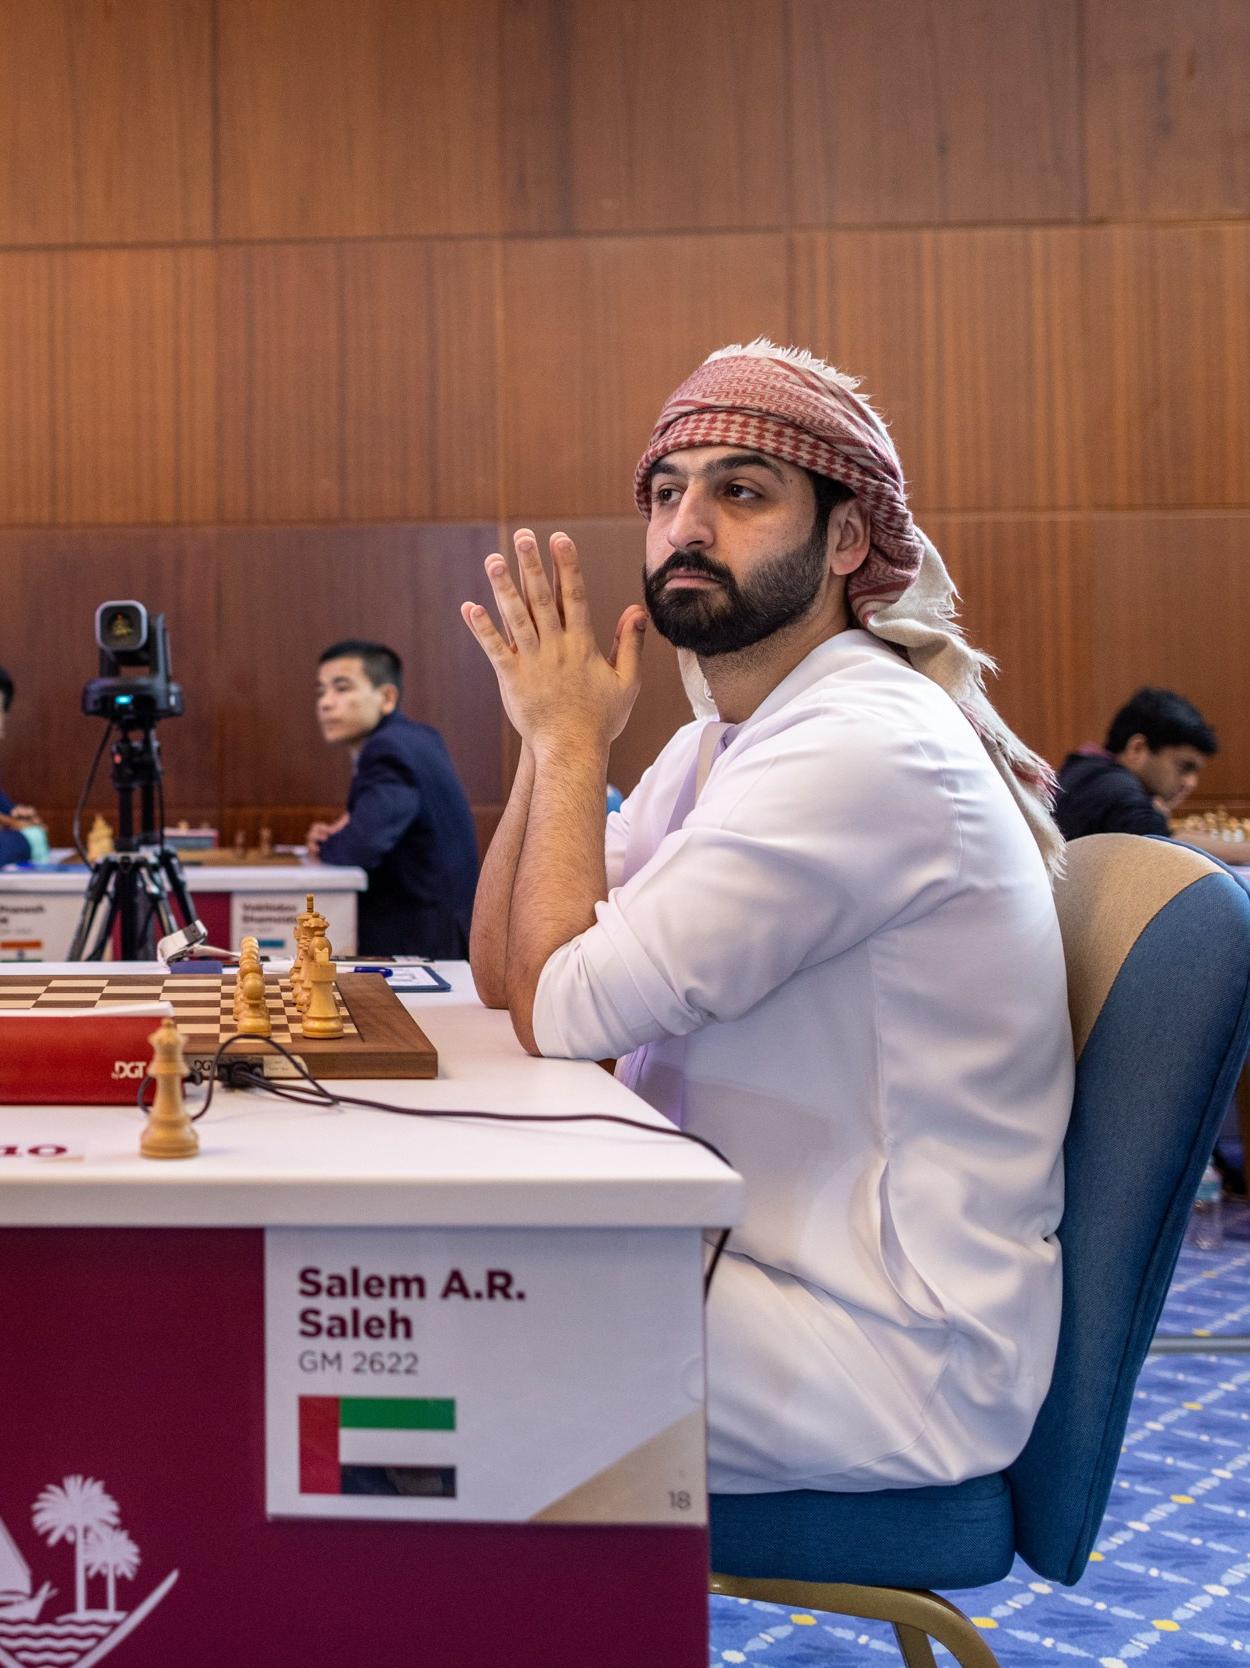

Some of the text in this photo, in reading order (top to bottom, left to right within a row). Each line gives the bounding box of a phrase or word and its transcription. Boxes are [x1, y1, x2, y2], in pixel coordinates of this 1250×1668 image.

[114, 1061, 147, 1079] DGT
[299, 1266, 526, 1300] Salem A.R.
[299, 1307, 413, 1340] Saleh
[298, 1350, 419, 1375] GM 2622
[667, 1490, 692, 1511] 18
